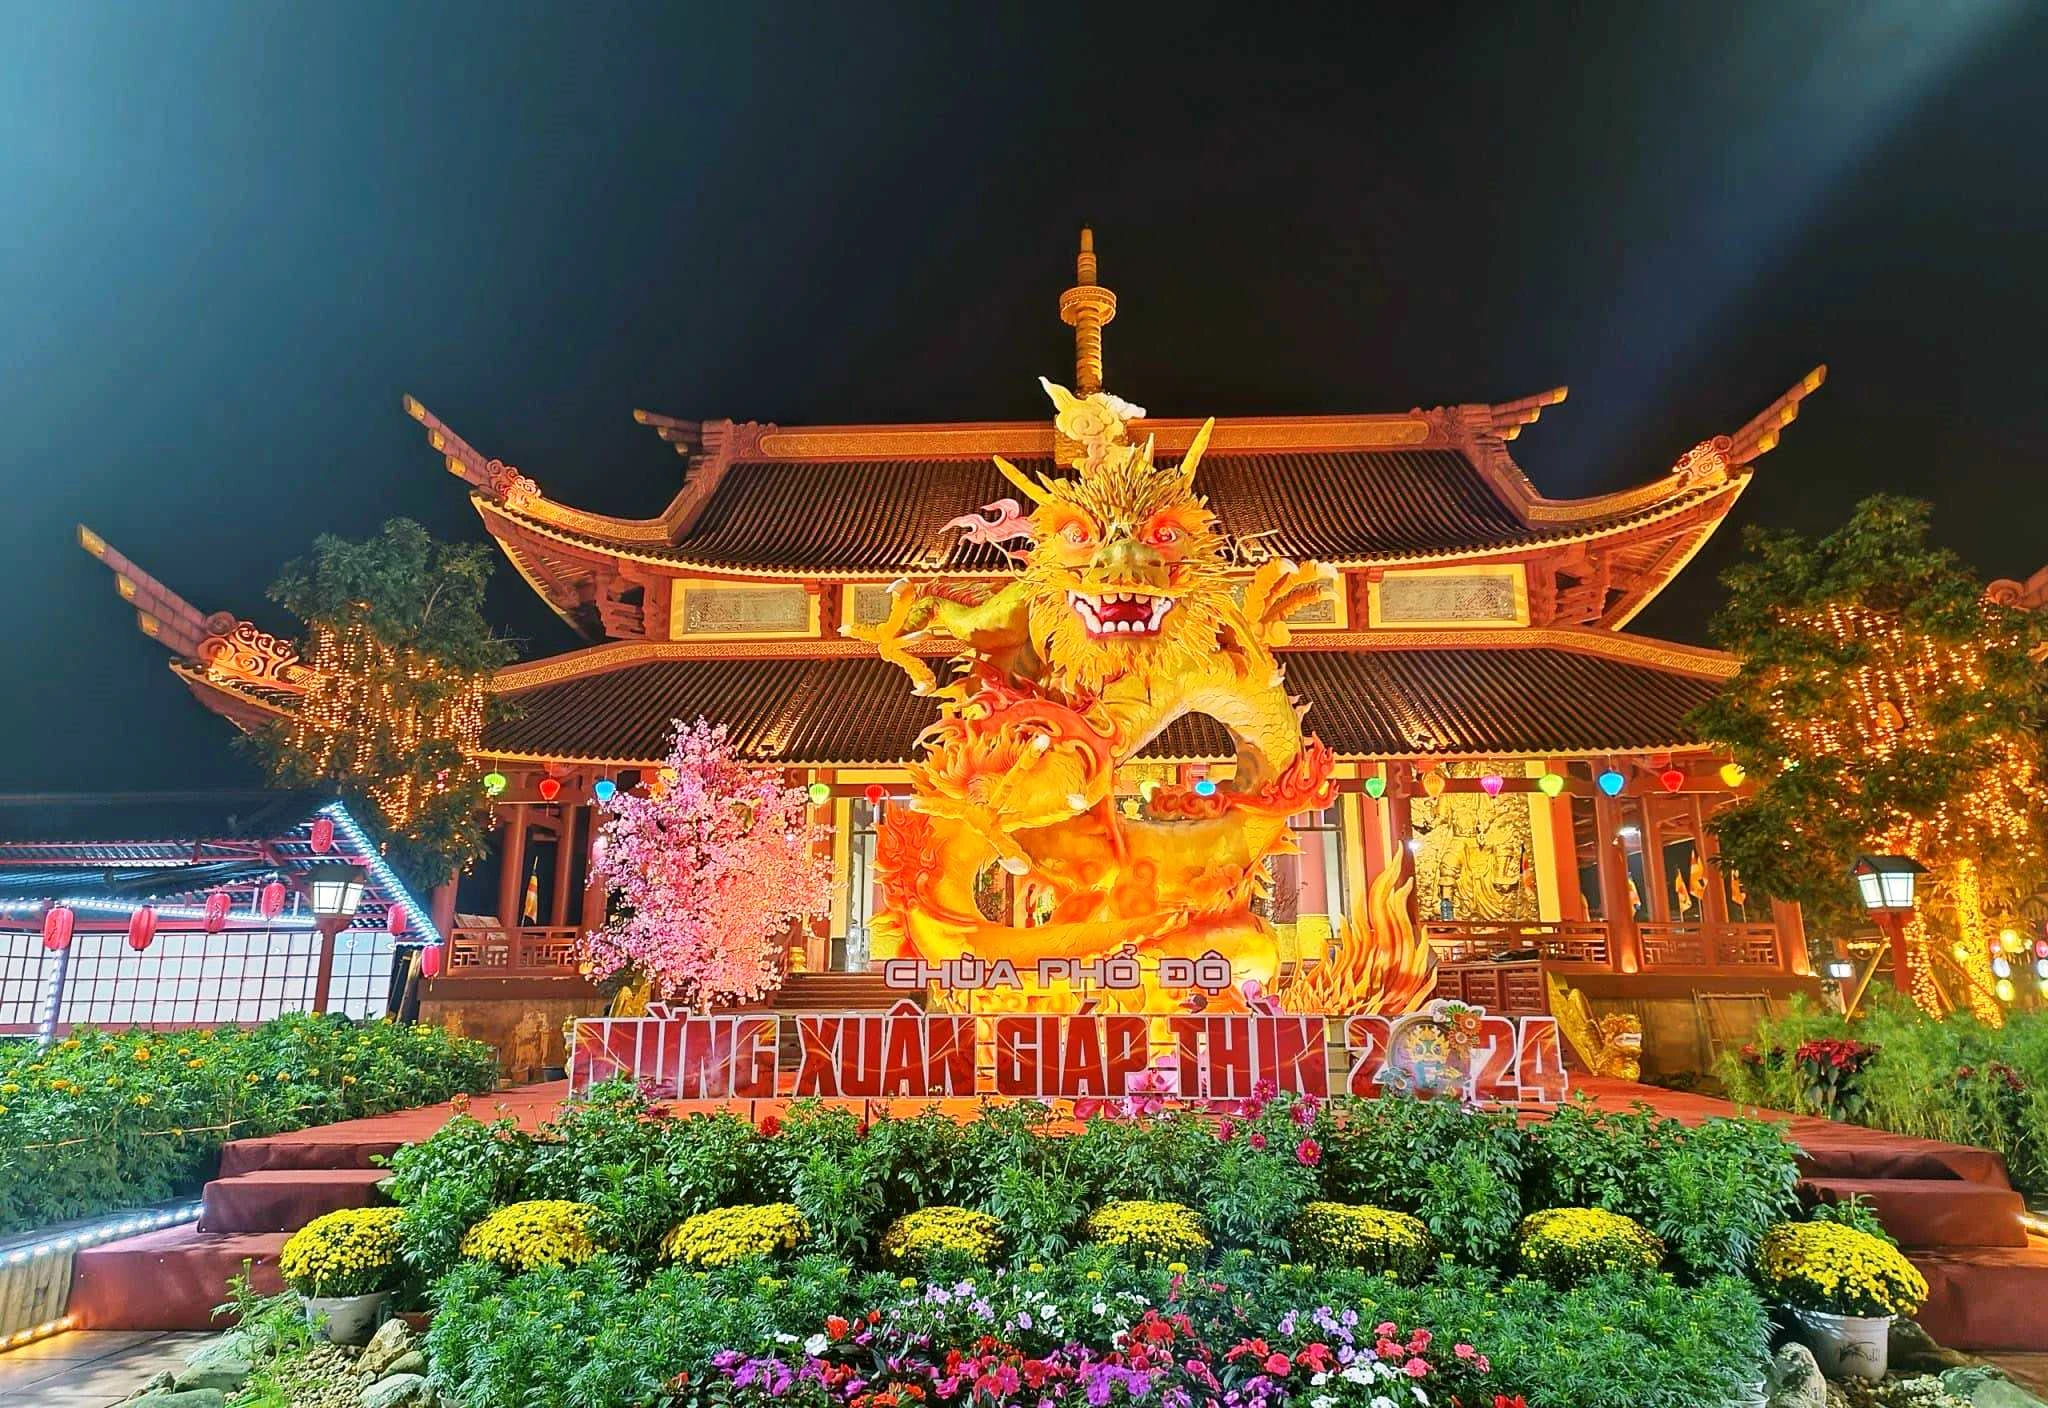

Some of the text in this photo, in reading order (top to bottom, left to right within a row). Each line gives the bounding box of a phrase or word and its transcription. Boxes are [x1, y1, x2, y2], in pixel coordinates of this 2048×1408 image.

[884, 943, 1232, 995] CHÙA PHỔ ĐỘ
[570, 1002, 780, 1100] MỪNG
[796, 999, 976, 1098] XUÂN
[996, 1000, 1150, 1098] GIÁP
[1168, 1000, 1330, 1100] THÌN
